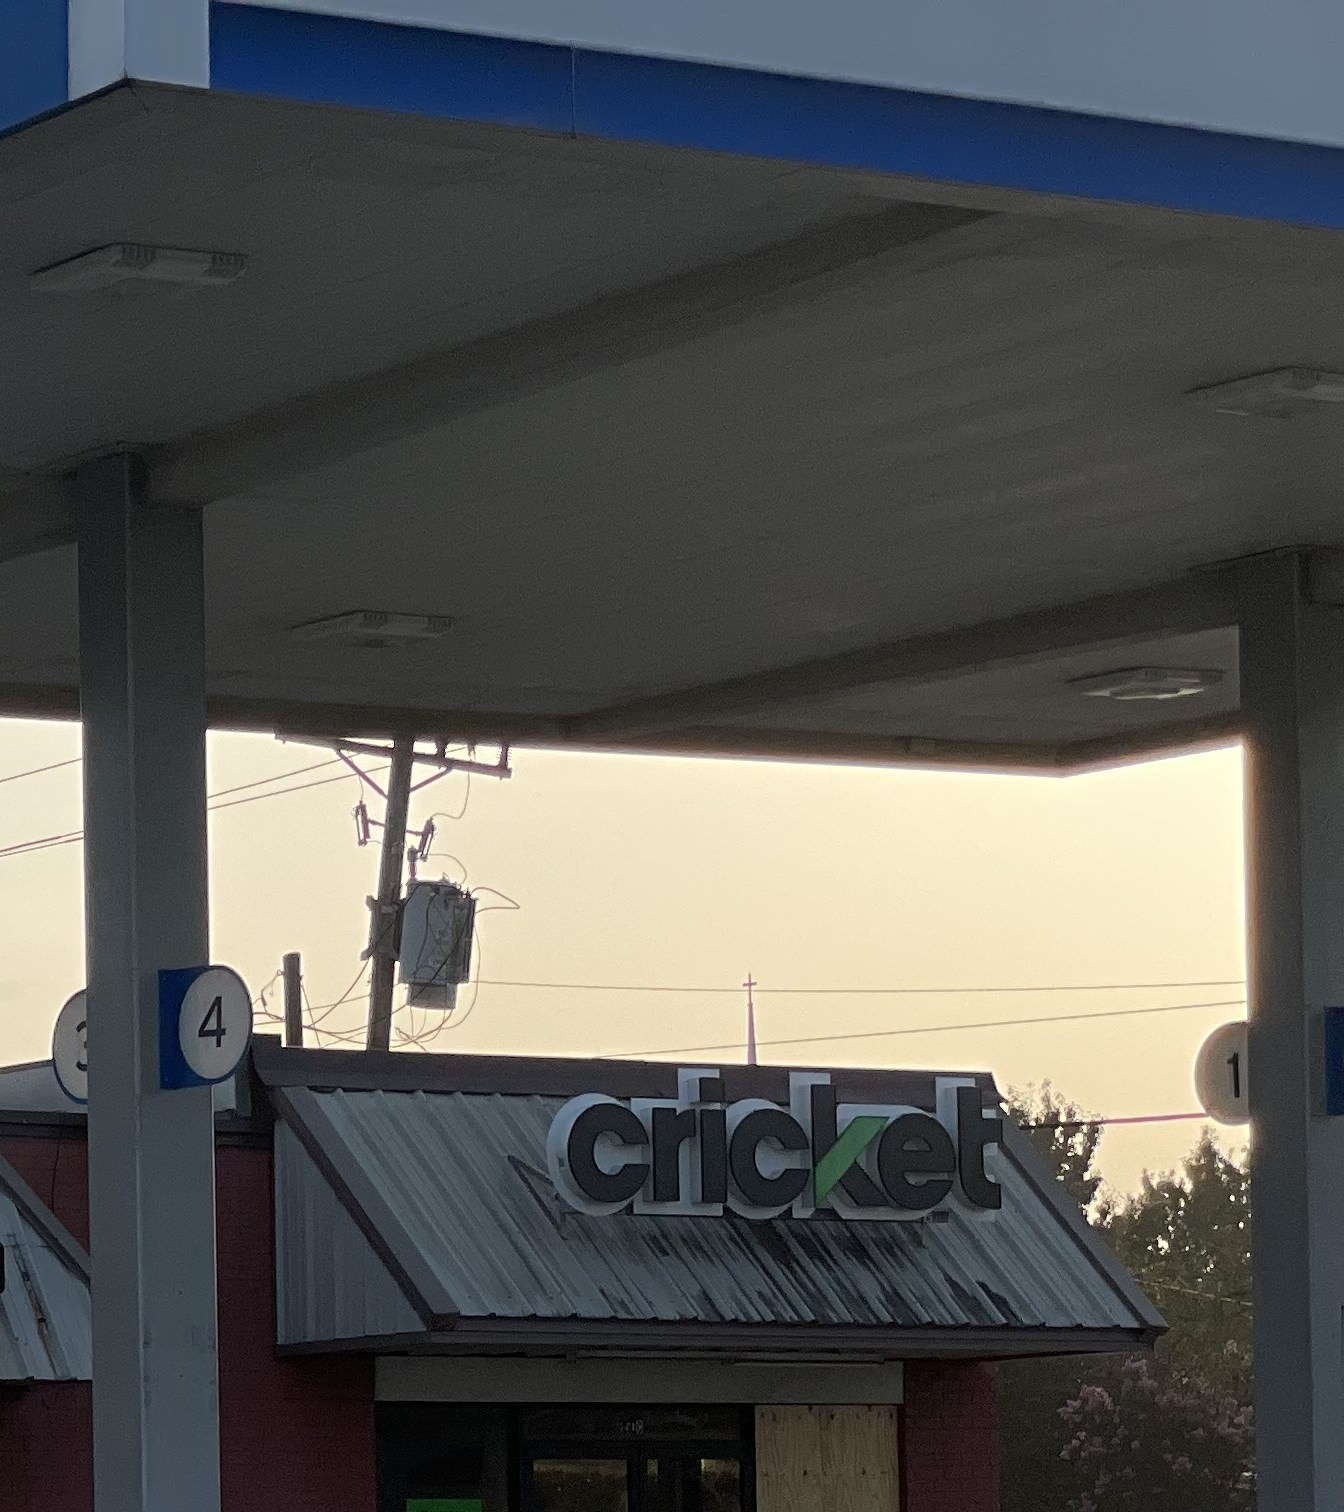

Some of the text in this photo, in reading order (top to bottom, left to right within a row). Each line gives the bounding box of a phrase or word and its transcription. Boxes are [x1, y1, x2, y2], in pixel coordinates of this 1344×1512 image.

[198, 996, 226, 1048] 4
[1227, 1052, 1240, 1098] 1
[557, 1071, 1003, 1216] cricket
